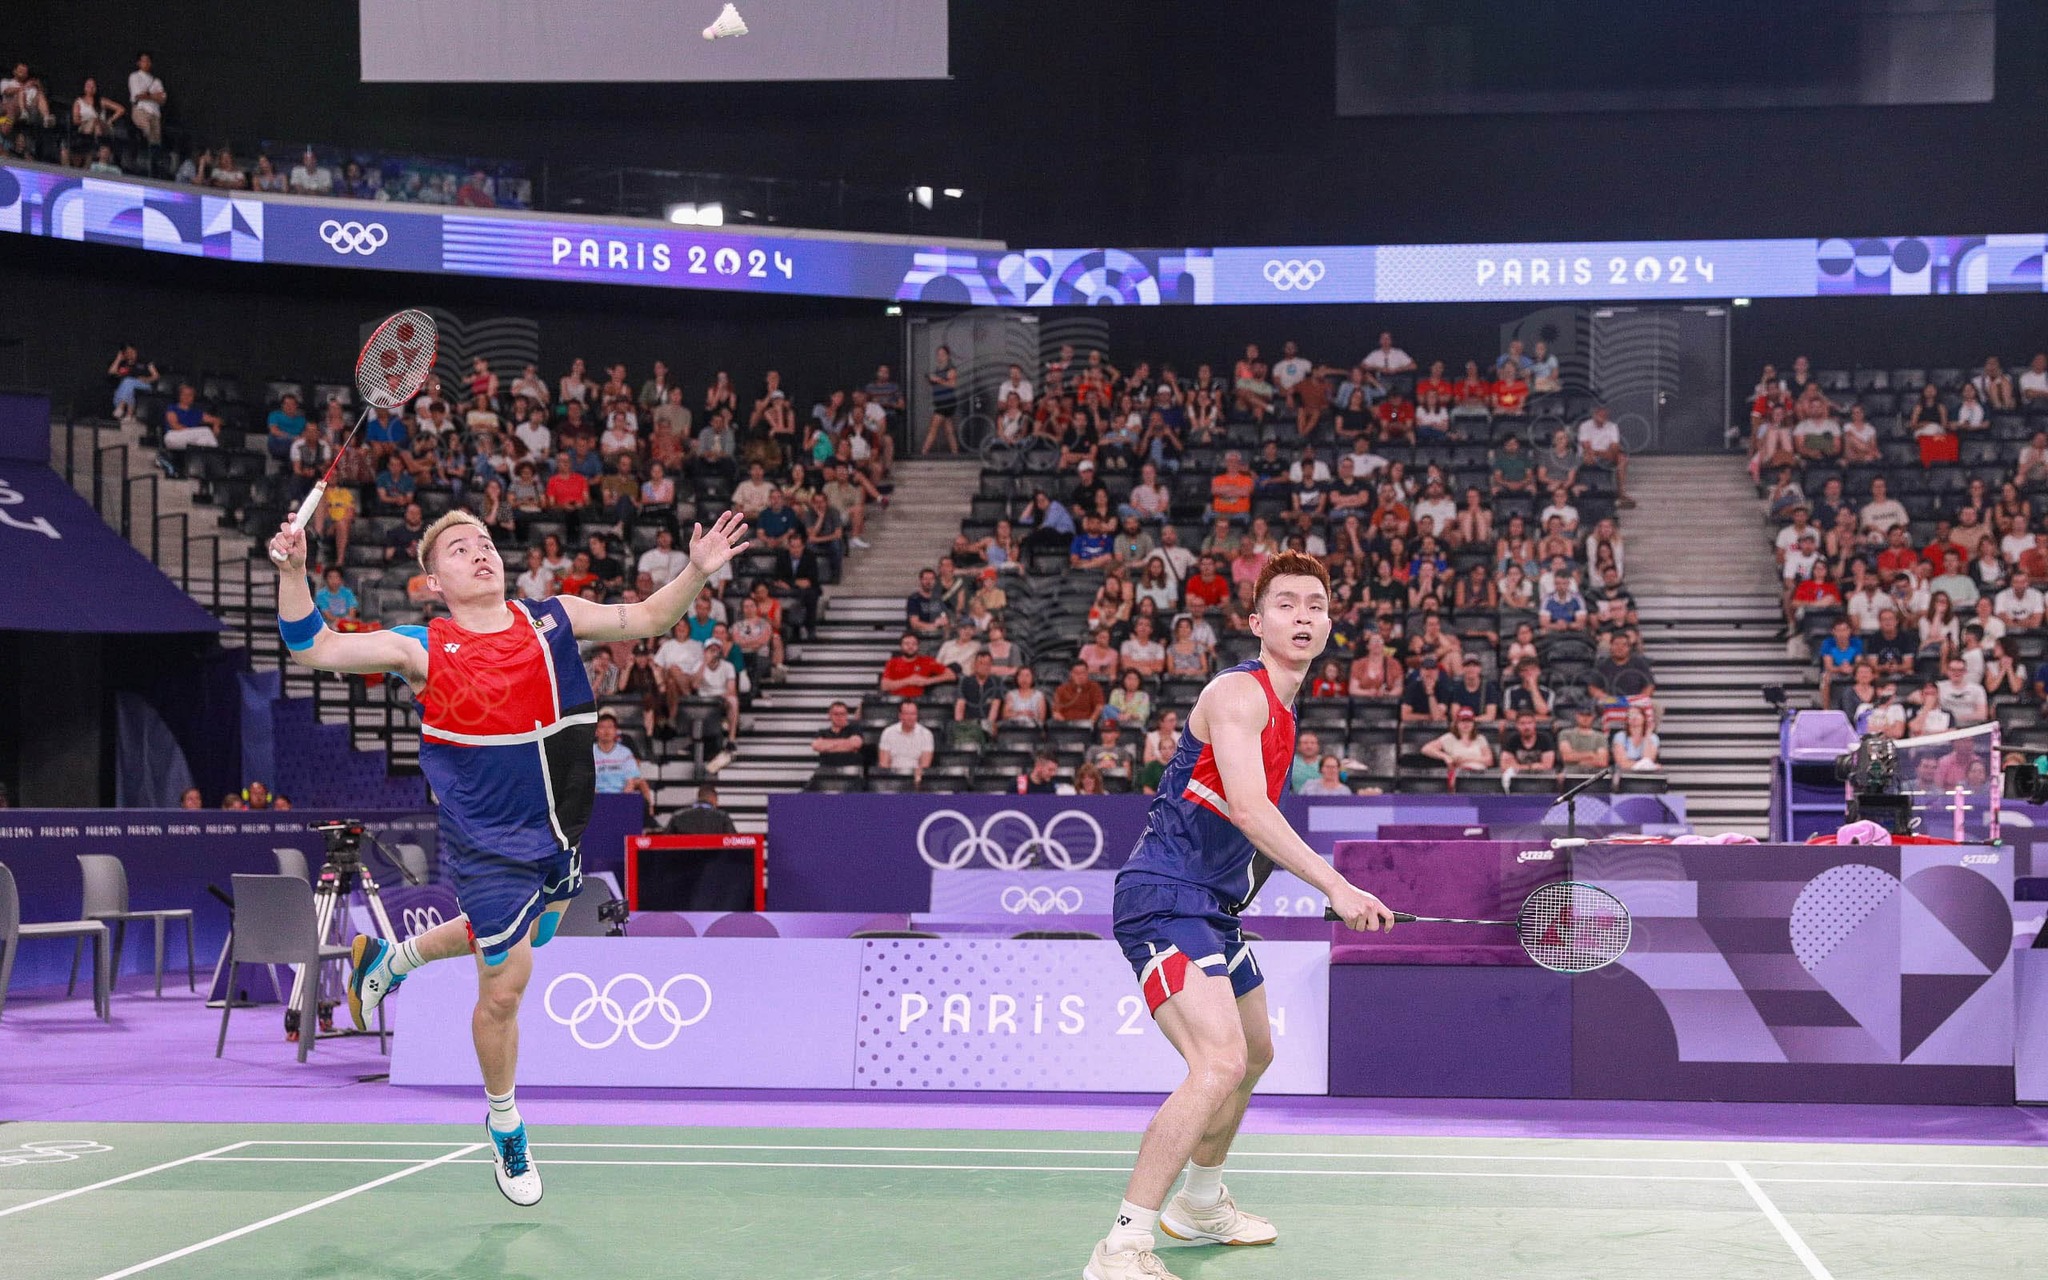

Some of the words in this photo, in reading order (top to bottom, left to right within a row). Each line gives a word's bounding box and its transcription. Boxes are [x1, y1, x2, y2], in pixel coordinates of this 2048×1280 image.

[552, 237, 671, 272] PARIS
[688, 245, 793, 280] 2024
[1476, 256, 1593, 287] PARIS
[1608, 255, 1714, 285] 2024
[1116, 995, 1286, 1036] 24
